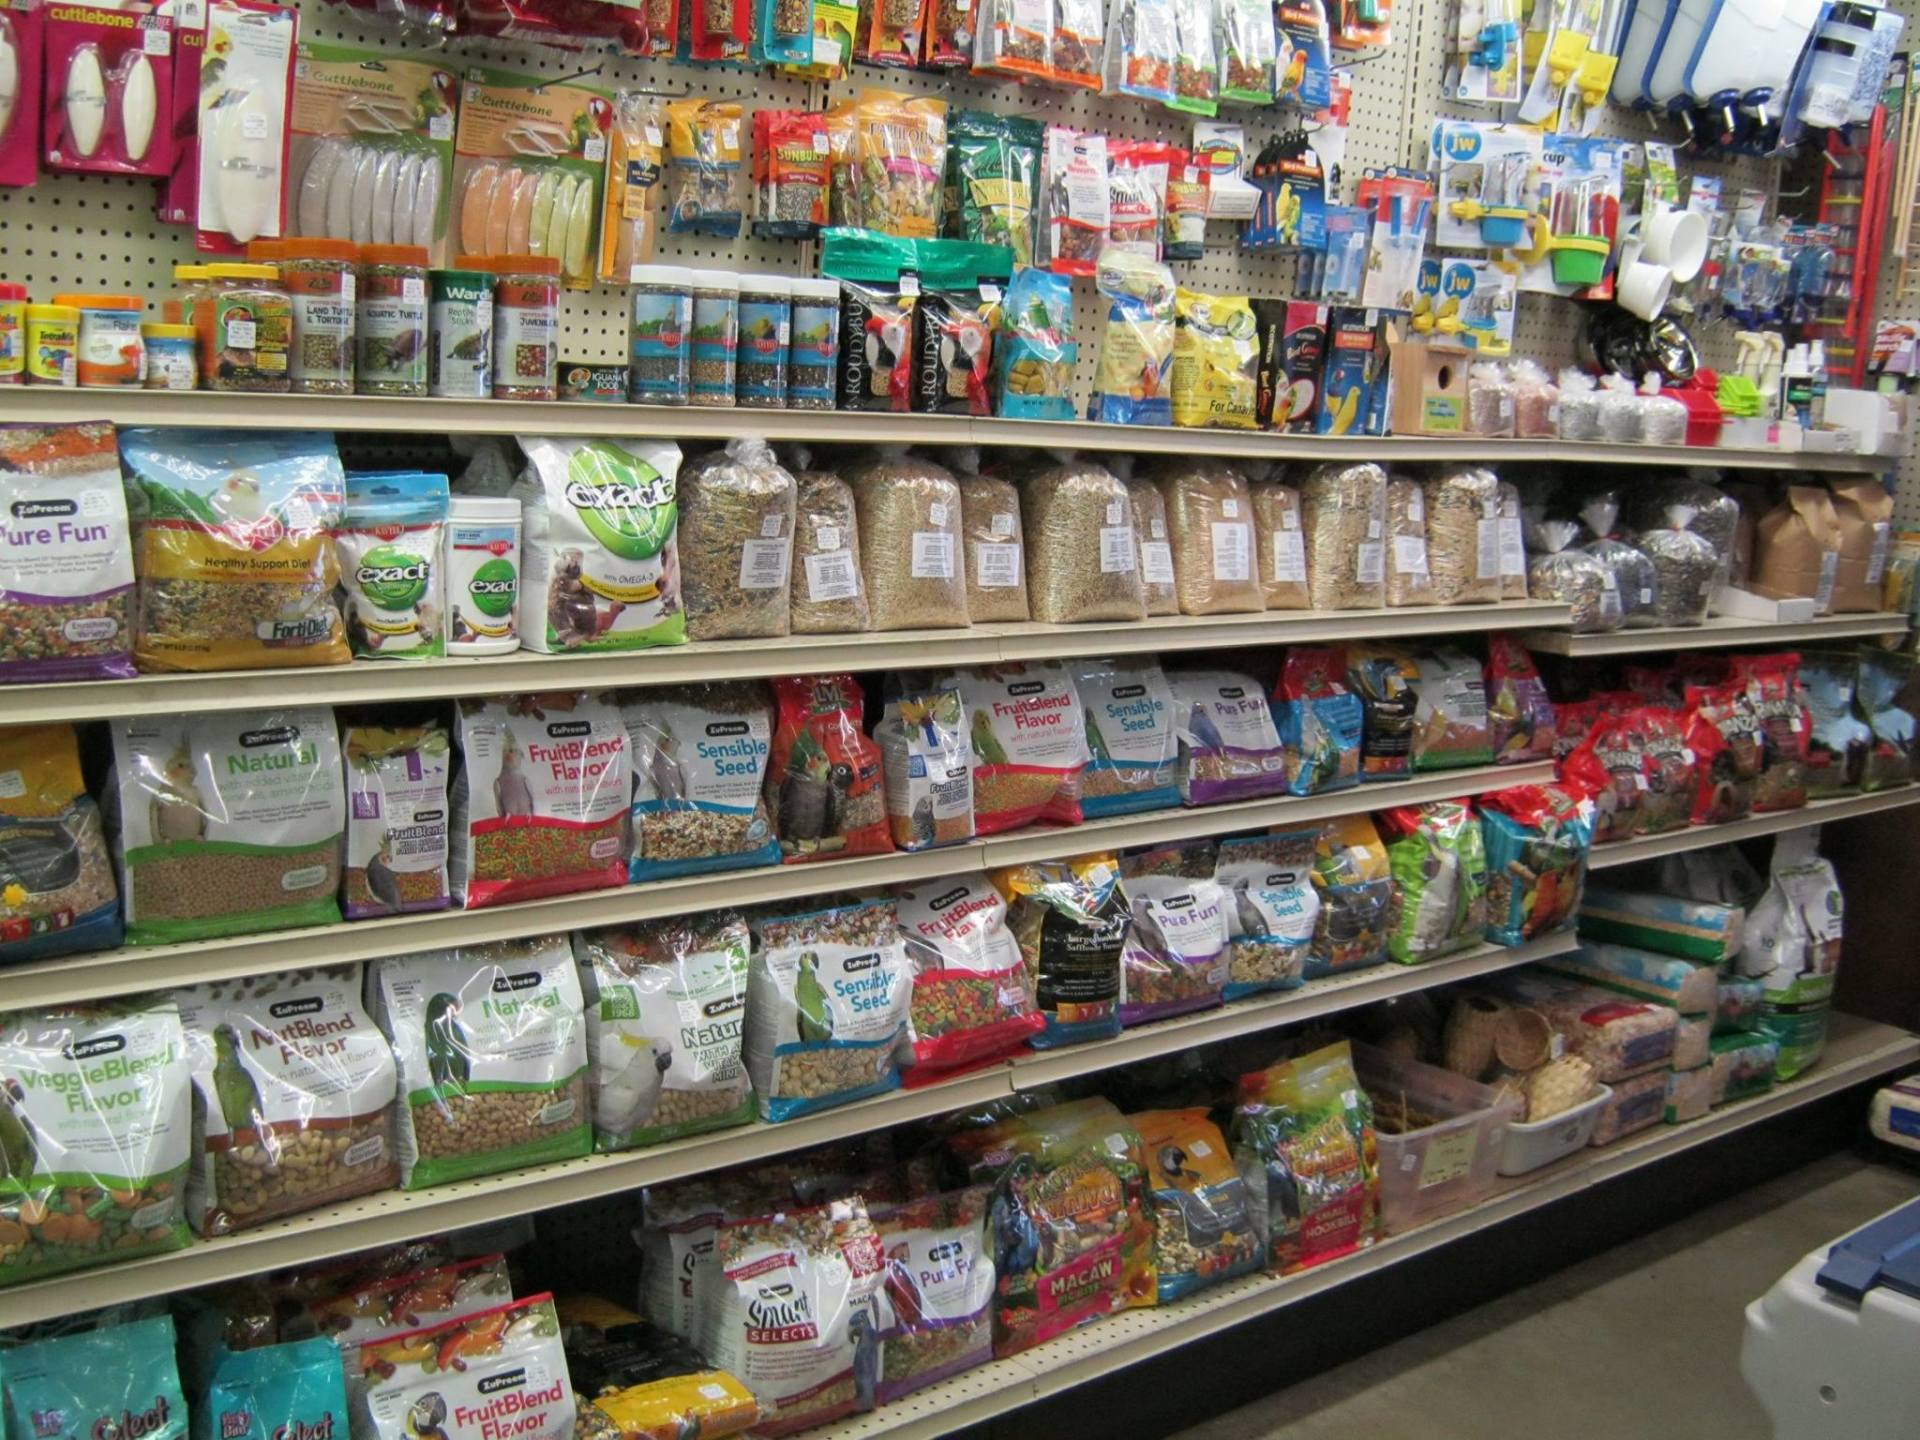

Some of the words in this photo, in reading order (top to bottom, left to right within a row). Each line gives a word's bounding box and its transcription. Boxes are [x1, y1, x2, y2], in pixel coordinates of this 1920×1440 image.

[50, 7, 134, 29] cuttlebone
[313, 68, 395, 93] Cuttlebone
[480, 94, 552, 118] Cuttlebone
[1543, 153, 1566, 167] cup
[1448, 273, 1471, 293] jw
[306, 306, 329, 315] LAND
[591, 372, 623, 382] IGUANA
[1209, 400, 1225, 414] For
[565, 475, 675, 510] exact
[18, 502, 72, 518] ZuPreem
[58, 522, 108, 545] Fun
[204, 556, 248, 571] Healthy
[250, 556, 289, 574] Support
[291, 555, 312, 571] Diet
[355, 560, 431, 585] exact
[619, 572, 655, 585] OMEGA-3
[992, 692, 1071, 721] FruitBlend
[1106, 697, 1164, 719] Sensible
[551, 722, 589, 735] ZuPreem
[709, 723, 747, 735] ZuPreem
[1014, 712, 1062, 732] Flavor
[1120, 715, 1156, 733] Seed
[227, 742, 322, 775] Natural
[528, 736, 624, 764] FruitBlend
[696, 738, 769, 760] Sensible
[550, 760, 610, 783] Flavor
[714, 758, 759, 778] Seed
[386, 822, 446, 842] FruitBlend
[916, 892, 998, 937] FruitBlend
[1187, 902, 1219, 925] Fun
[833, 973, 896, 1001] Sensible
[275, 1000, 320, 1016] ZuPreem
[480, 986, 561, 1020] Natural
[850, 990, 891, 1015] Seed
[250, 1012, 356, 1051] NutBlend
[281, 1034, 348, 1066] Flavor
[18, 1042, 174, 1096] VeggieBlend
[66, 1086, 145, 1114] Flavor
[1050, 1258, 1114, 1297] MACAW
[743, 1289, 812, 1331] Smart
[750, 1326, 816, 1343] SELECTS
[454, 1378, 563, 1429] FruitBlend
[90, 1394, 171, 1440] Select
[272, 1410, 333, 1440] Select
[480, 1411, 550, 1440] Flavor
